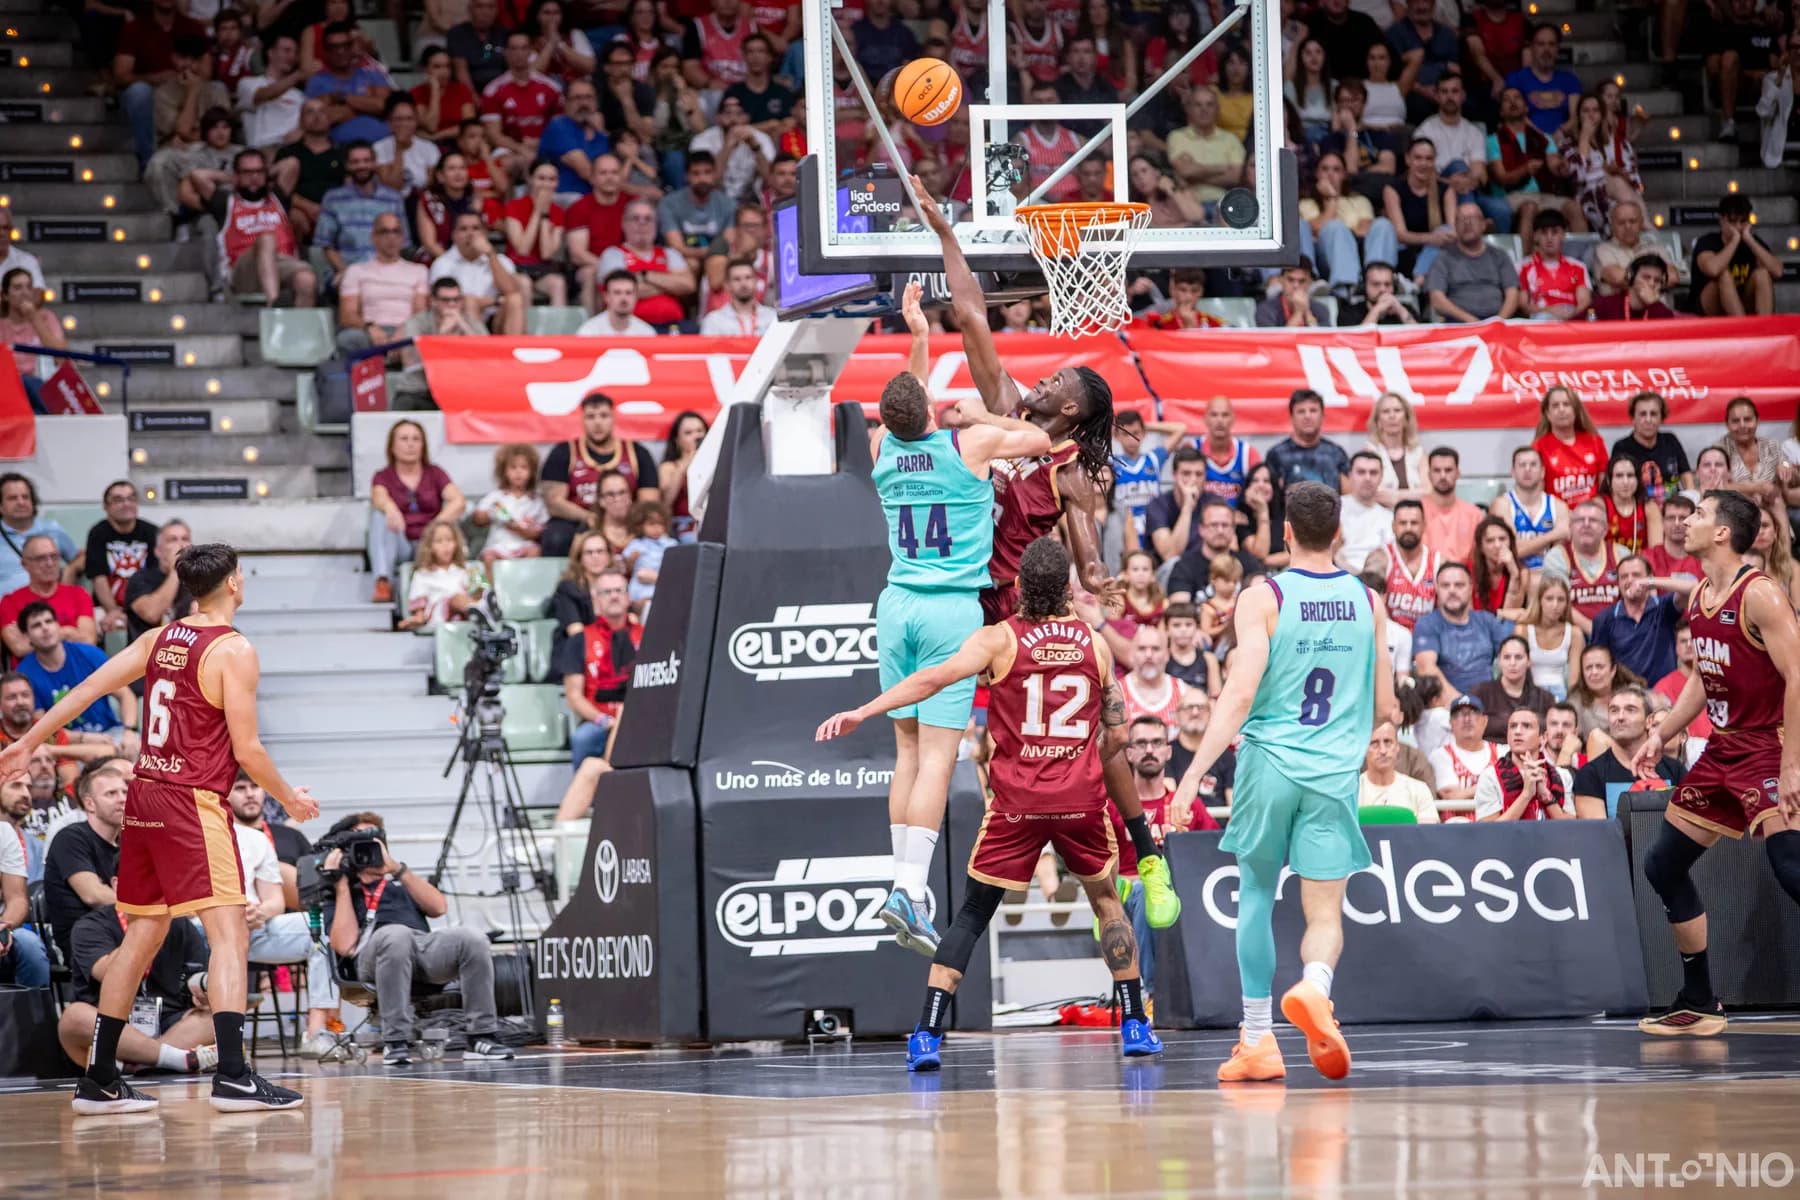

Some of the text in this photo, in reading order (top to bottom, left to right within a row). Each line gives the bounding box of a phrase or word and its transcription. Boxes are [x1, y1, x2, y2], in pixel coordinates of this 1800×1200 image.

[923, 86, 959, 121] Wilson
[850, 189, 874, 202] liga
[851, 201, 900, 213] endesa
[1502, 367, 1691, 392] AGENCIA DE
[897, 453, 934, 473] PARRA
[898, 503, 953, 559] 44
[1300, 600, 1357, 622] BRIZUELA
[147, 678, 177, 748] 6
[1020, 672, 1091, 739] 12
[1298, 667, 1336, 726] 8
[716, 767, 894, 790] Uno más de la fam
[622, 858, 652, 884] LABASA
[1202, 840, 1589, 930] edesa
[724, 887, 889, 936] eLPOZ
[537, 934, 654, 979] LET'S GO BEYOND
